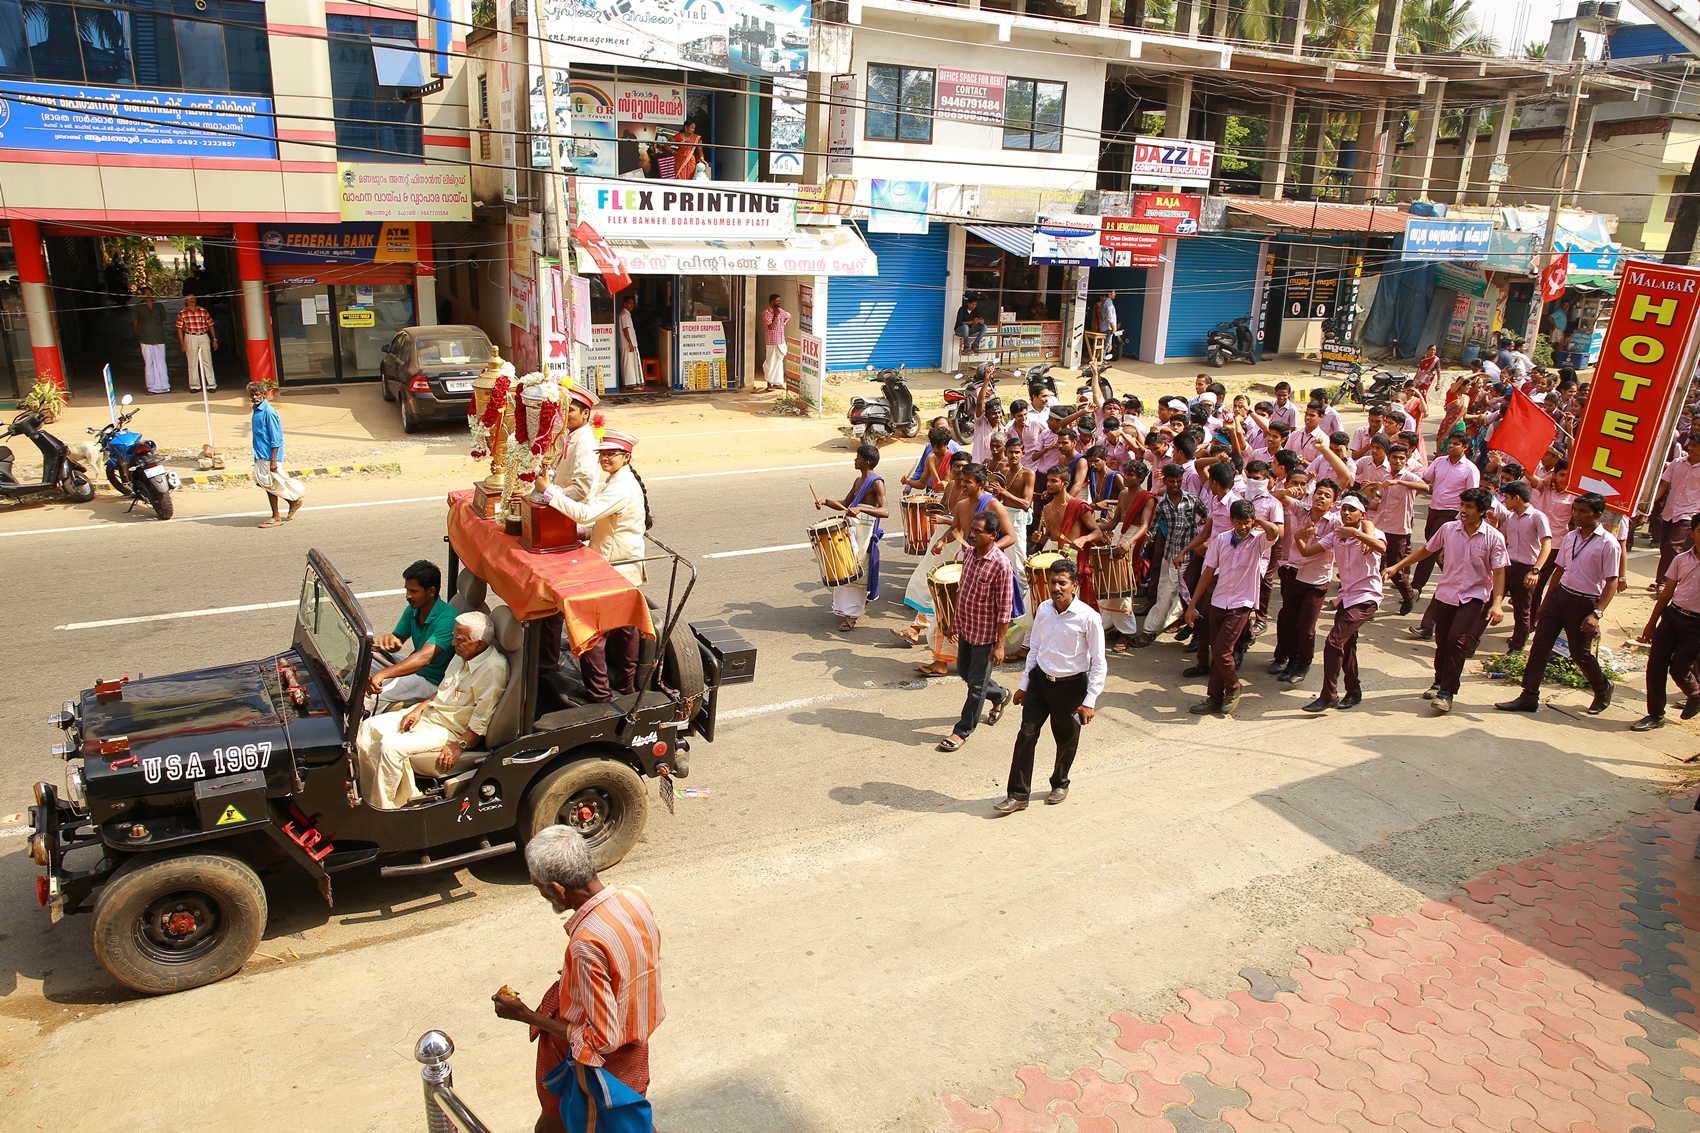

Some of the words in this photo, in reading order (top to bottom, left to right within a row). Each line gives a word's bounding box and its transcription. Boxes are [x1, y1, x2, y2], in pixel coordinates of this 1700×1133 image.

[567, 35, 630, 46] management
[940, 70, 959, 82] OFFICE
[959, 72, 978, 84] SPACE
[978, 75, 989, 85] FOR
[989, 76, 1004, 87] RENT
[955, 85, 987, 96] CONTACT
[941, 96, 1000, 111] 9446791484
[1135, 144, 1212, 168] DAZZLE
[1135, 164, 1171, 173] COMPUTER
[1172, 167, 1209, 176] EDUCATION
[342, 192, 373, 202] വാഹന
[403, 193, 409, 202] &
[410, 193, 440, 206] വ്യാപാര
[597, 189, 654, 211] FLEX
[663, 191, 780, 214] PRINTING
[1155, 197, 1180, 209] RAJA
[608, 216, 628, 224] FLEX
[745, 219, 771, 227] PLATE
[386, 228, 409, 237] ATM
[287, 233, 339, 248] FEDERAL
[343, 234, 374, 248] BANK
[767, 258, 778, 270] &
[803, 338, 819, 358] FLEX
[802, 355, 819, 369] PRINTING
[1591, 294, 1679, 479] HOTEL
[142, 751, 206, 785] USA
[212, 741, 273, 775] 1967
